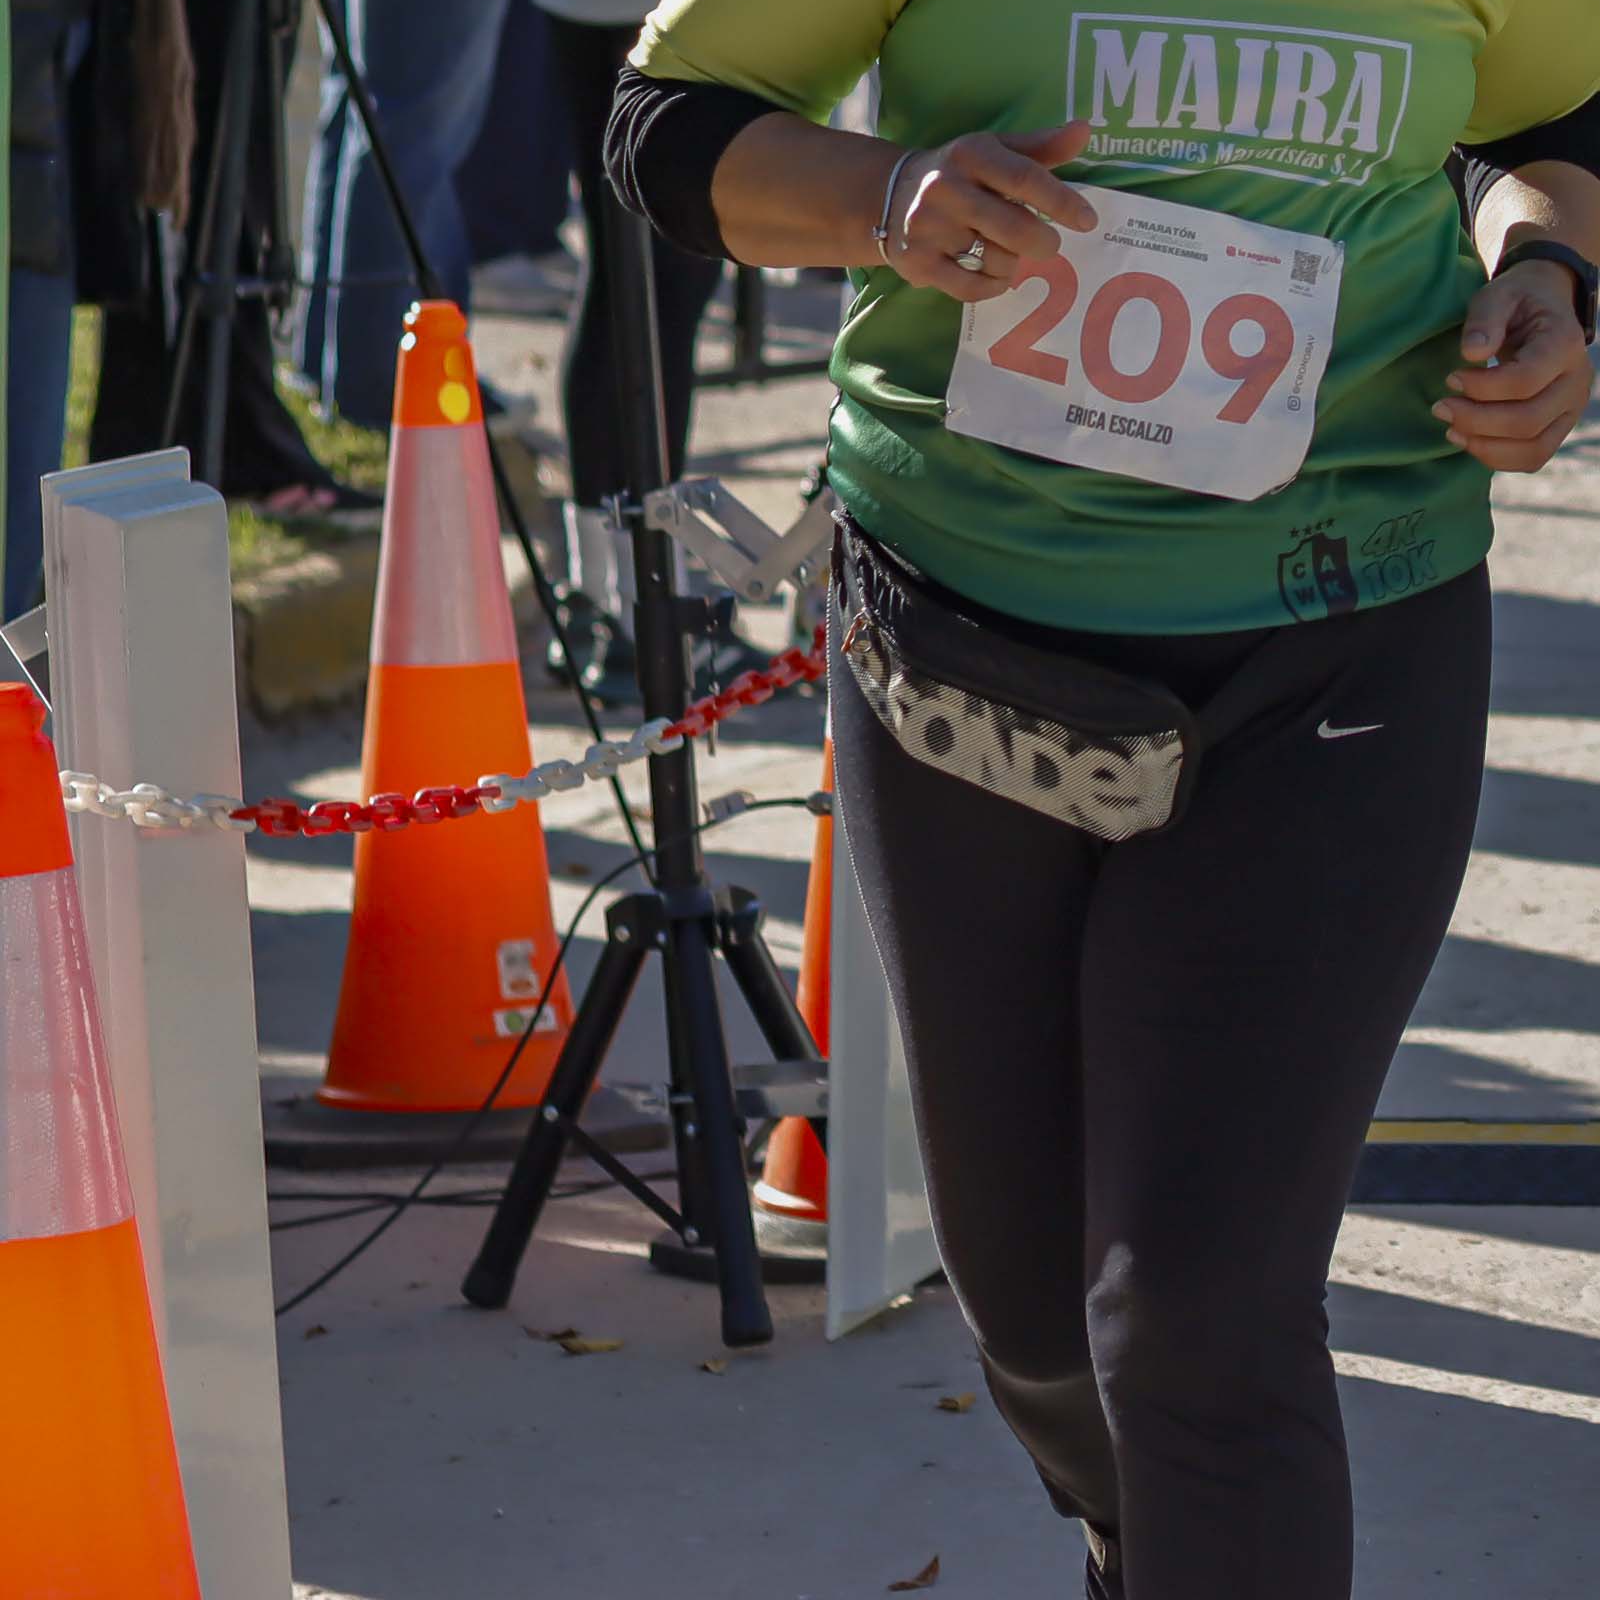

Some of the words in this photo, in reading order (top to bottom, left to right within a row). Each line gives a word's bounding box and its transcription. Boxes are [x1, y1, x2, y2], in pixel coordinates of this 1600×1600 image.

[1088, 28, 1382, 153] MAIRA
[1087, 133, 1208, 164] Almacenes
[987, 250, 1295, 424] 209
[1065, 404, 1105, 430] ERICA
[1108, 414, 1174, 446] ESCALZO
